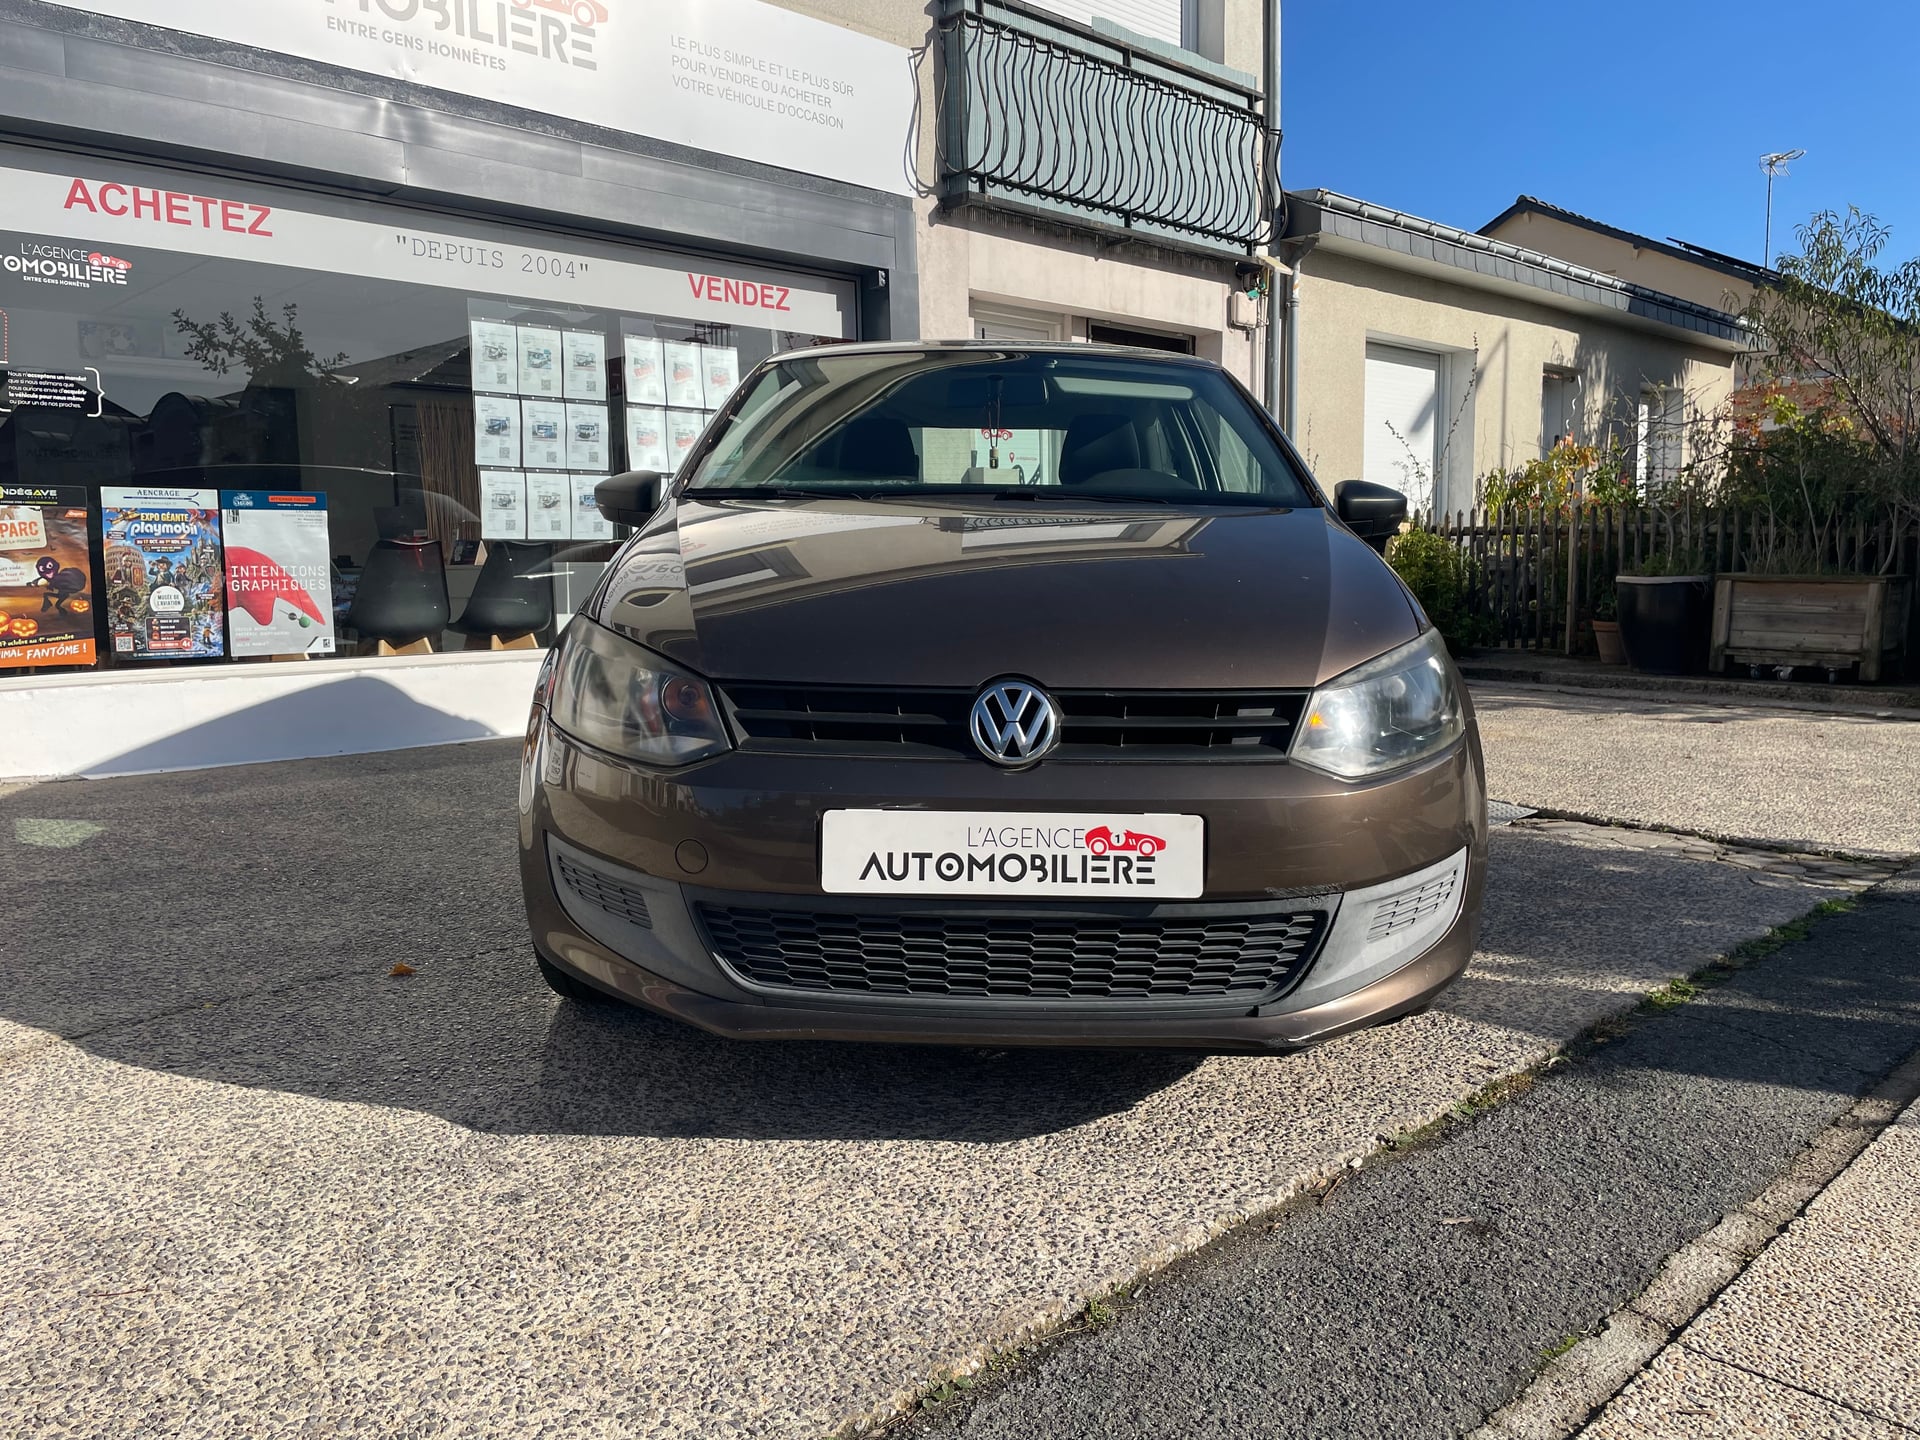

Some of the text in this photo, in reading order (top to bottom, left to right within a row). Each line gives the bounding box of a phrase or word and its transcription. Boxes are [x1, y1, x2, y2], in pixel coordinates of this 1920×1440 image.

[326, 15, 506, 71] ENTRE GENS HONNÊTES
[671, 35, 854, 97] LE PLUS SIMPLE ET LE PLUS SÛR
[672, 55, 832, 109] POUR VENDRE OU ACHETER
[672, 74, 844, 129] VOTRE VÉHICULE D'OCCASION
[63, 178, 273, 237] ACHETEZ
[20, 242, 89, 262] L'AGENCE
[0, 254, 128, 285] OMOBILIERE
[23, 275, 42, 283] ENTRE
[59, 280, 90, 288] HONNÊTES
[688, 273, 790, 311] VENDEZ
[137, 489, 180, 497] AENCRAGE
[141, 511, 189, 522] EXPO GÉANTE
[0, 521, 38, 537] PARC
[130, 522, 198, 537] playmobil
[231, 566, 326, 577] INTENTIONS
[231, 579, 326, 591] GRAPHIQUES
[967, 825, 1086, 849] L'AGENCE
